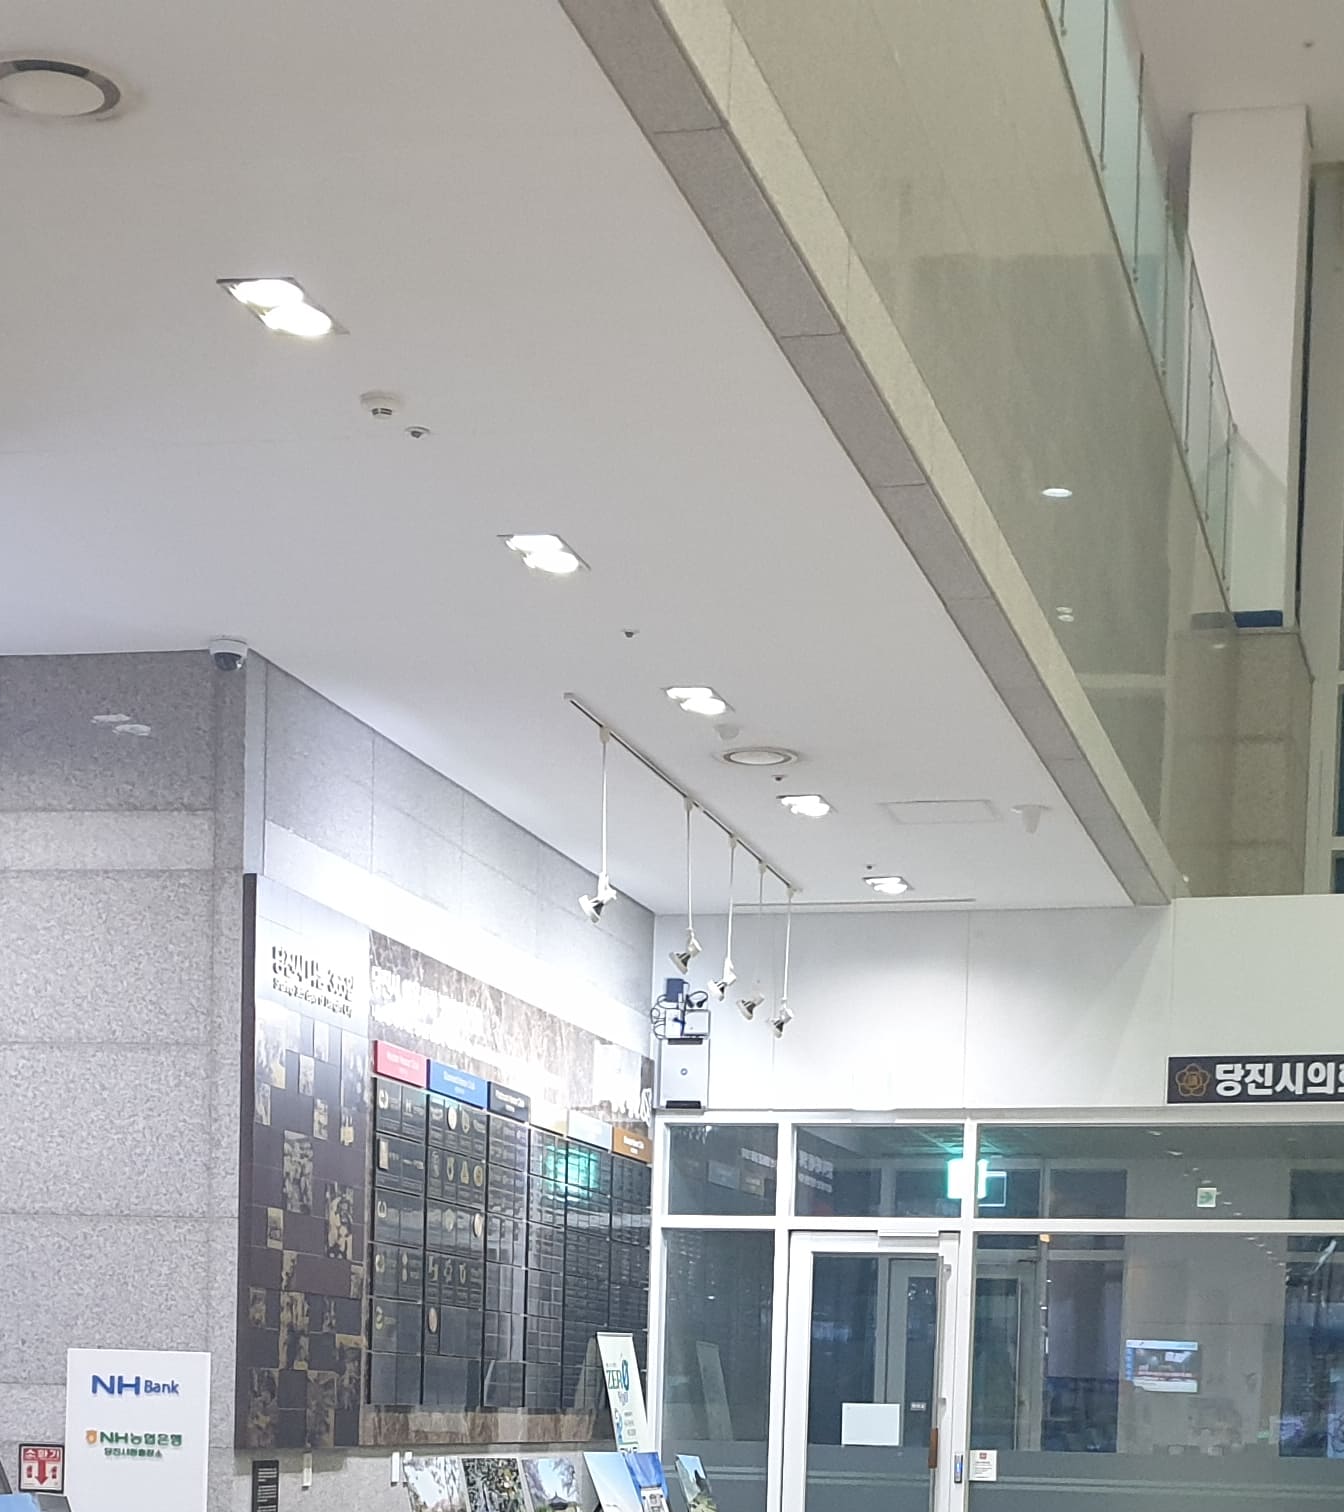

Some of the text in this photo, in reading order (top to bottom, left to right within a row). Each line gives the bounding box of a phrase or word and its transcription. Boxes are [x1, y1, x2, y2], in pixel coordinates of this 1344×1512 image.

[92, 1375, 179, 1395] NH Bank
[100, 1431, 182, 1446] NH농협은행
